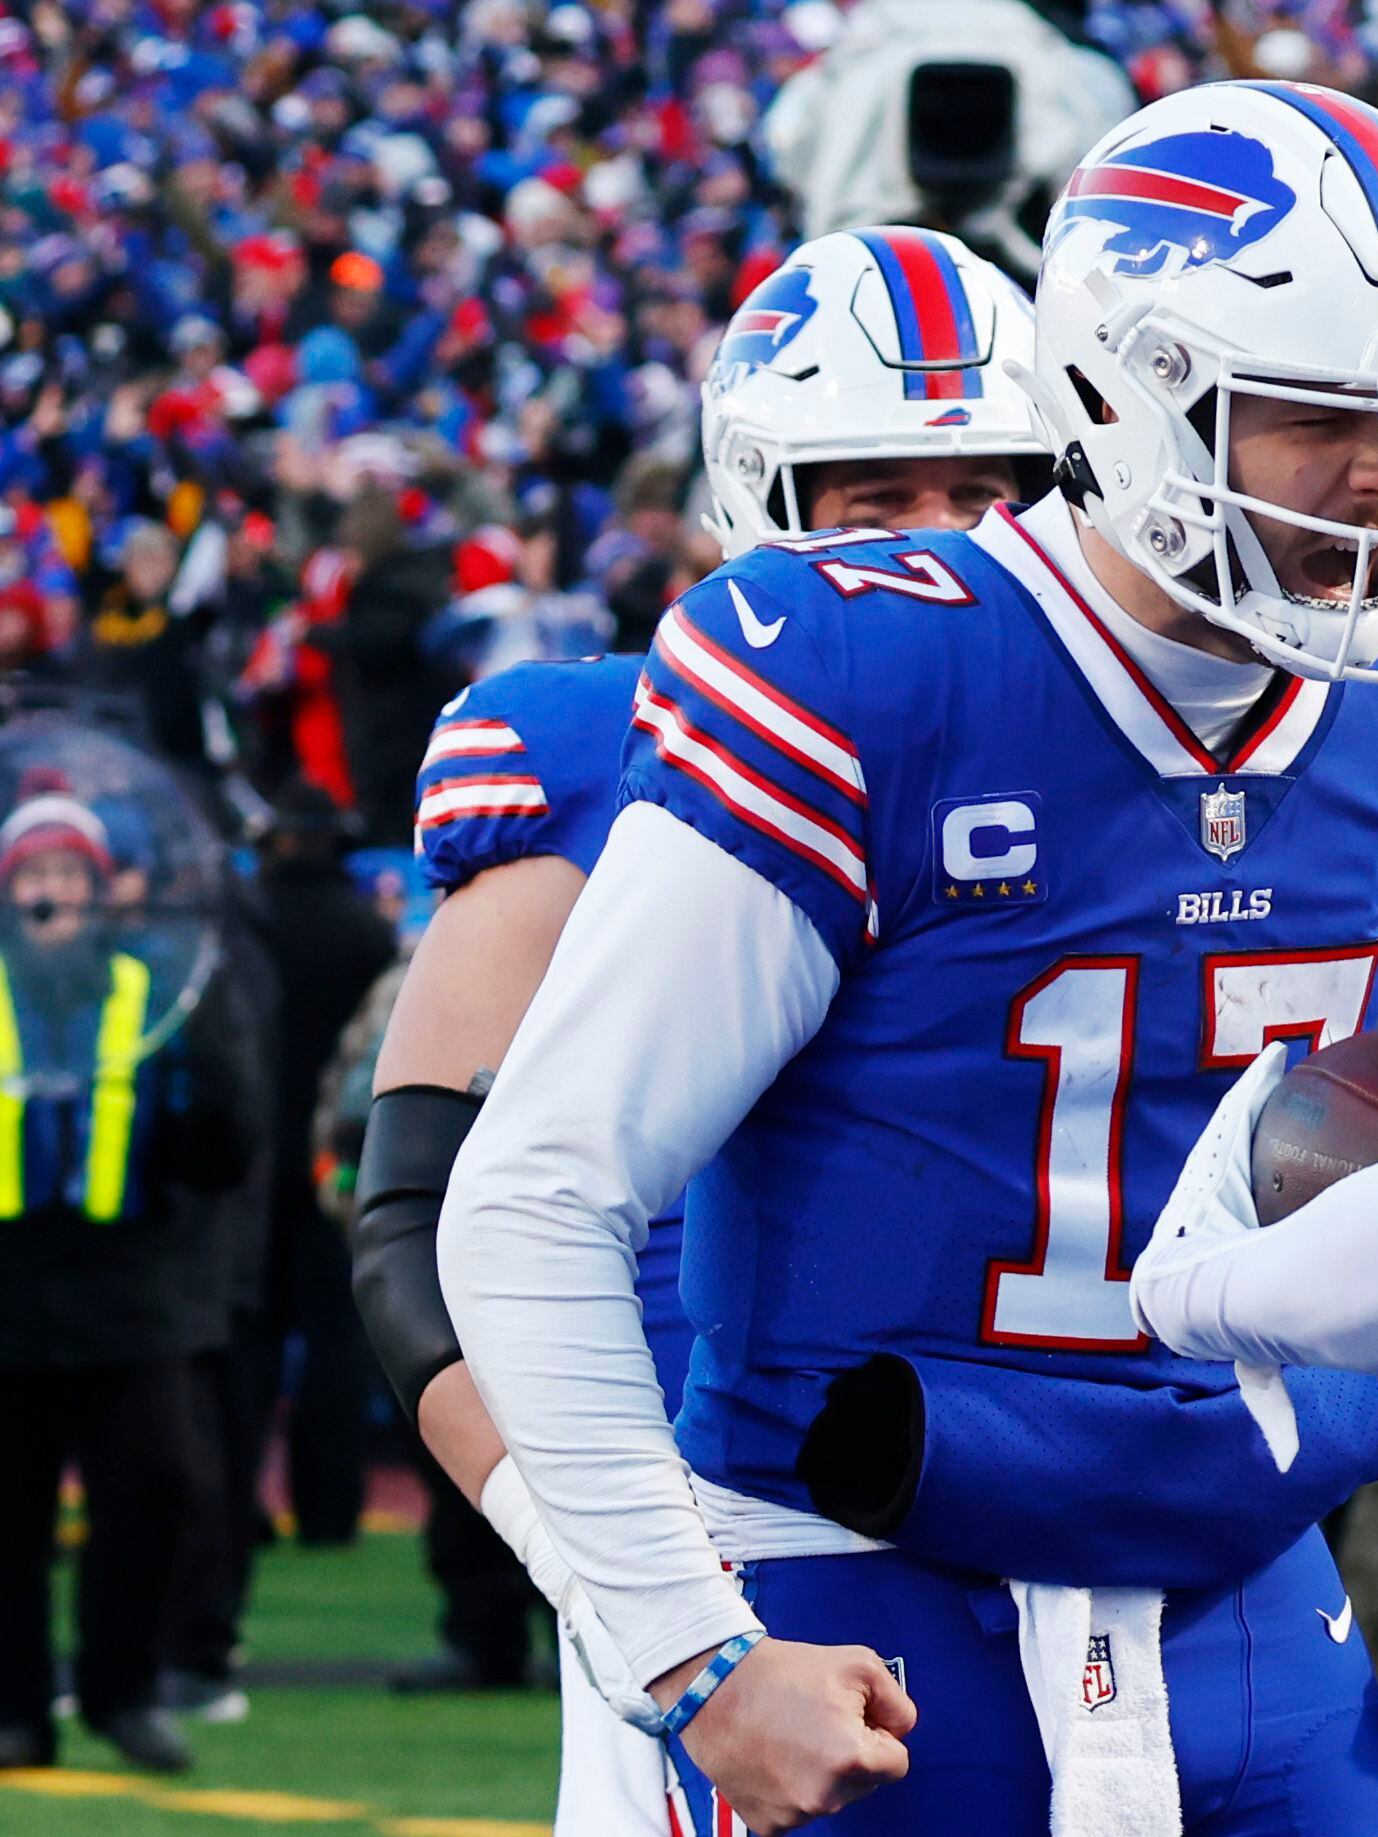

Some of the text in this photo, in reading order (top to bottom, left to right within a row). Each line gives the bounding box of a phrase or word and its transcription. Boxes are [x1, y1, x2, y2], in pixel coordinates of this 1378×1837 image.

[942, 800, 1037, 881] C
[1209, 819, 1241, 847] NFL
[1175, 888, 1273, 926] BILLS
[1312, 1151, 1363, 1174] IONAL
[1082, 1664, 1112, 1704] FL
